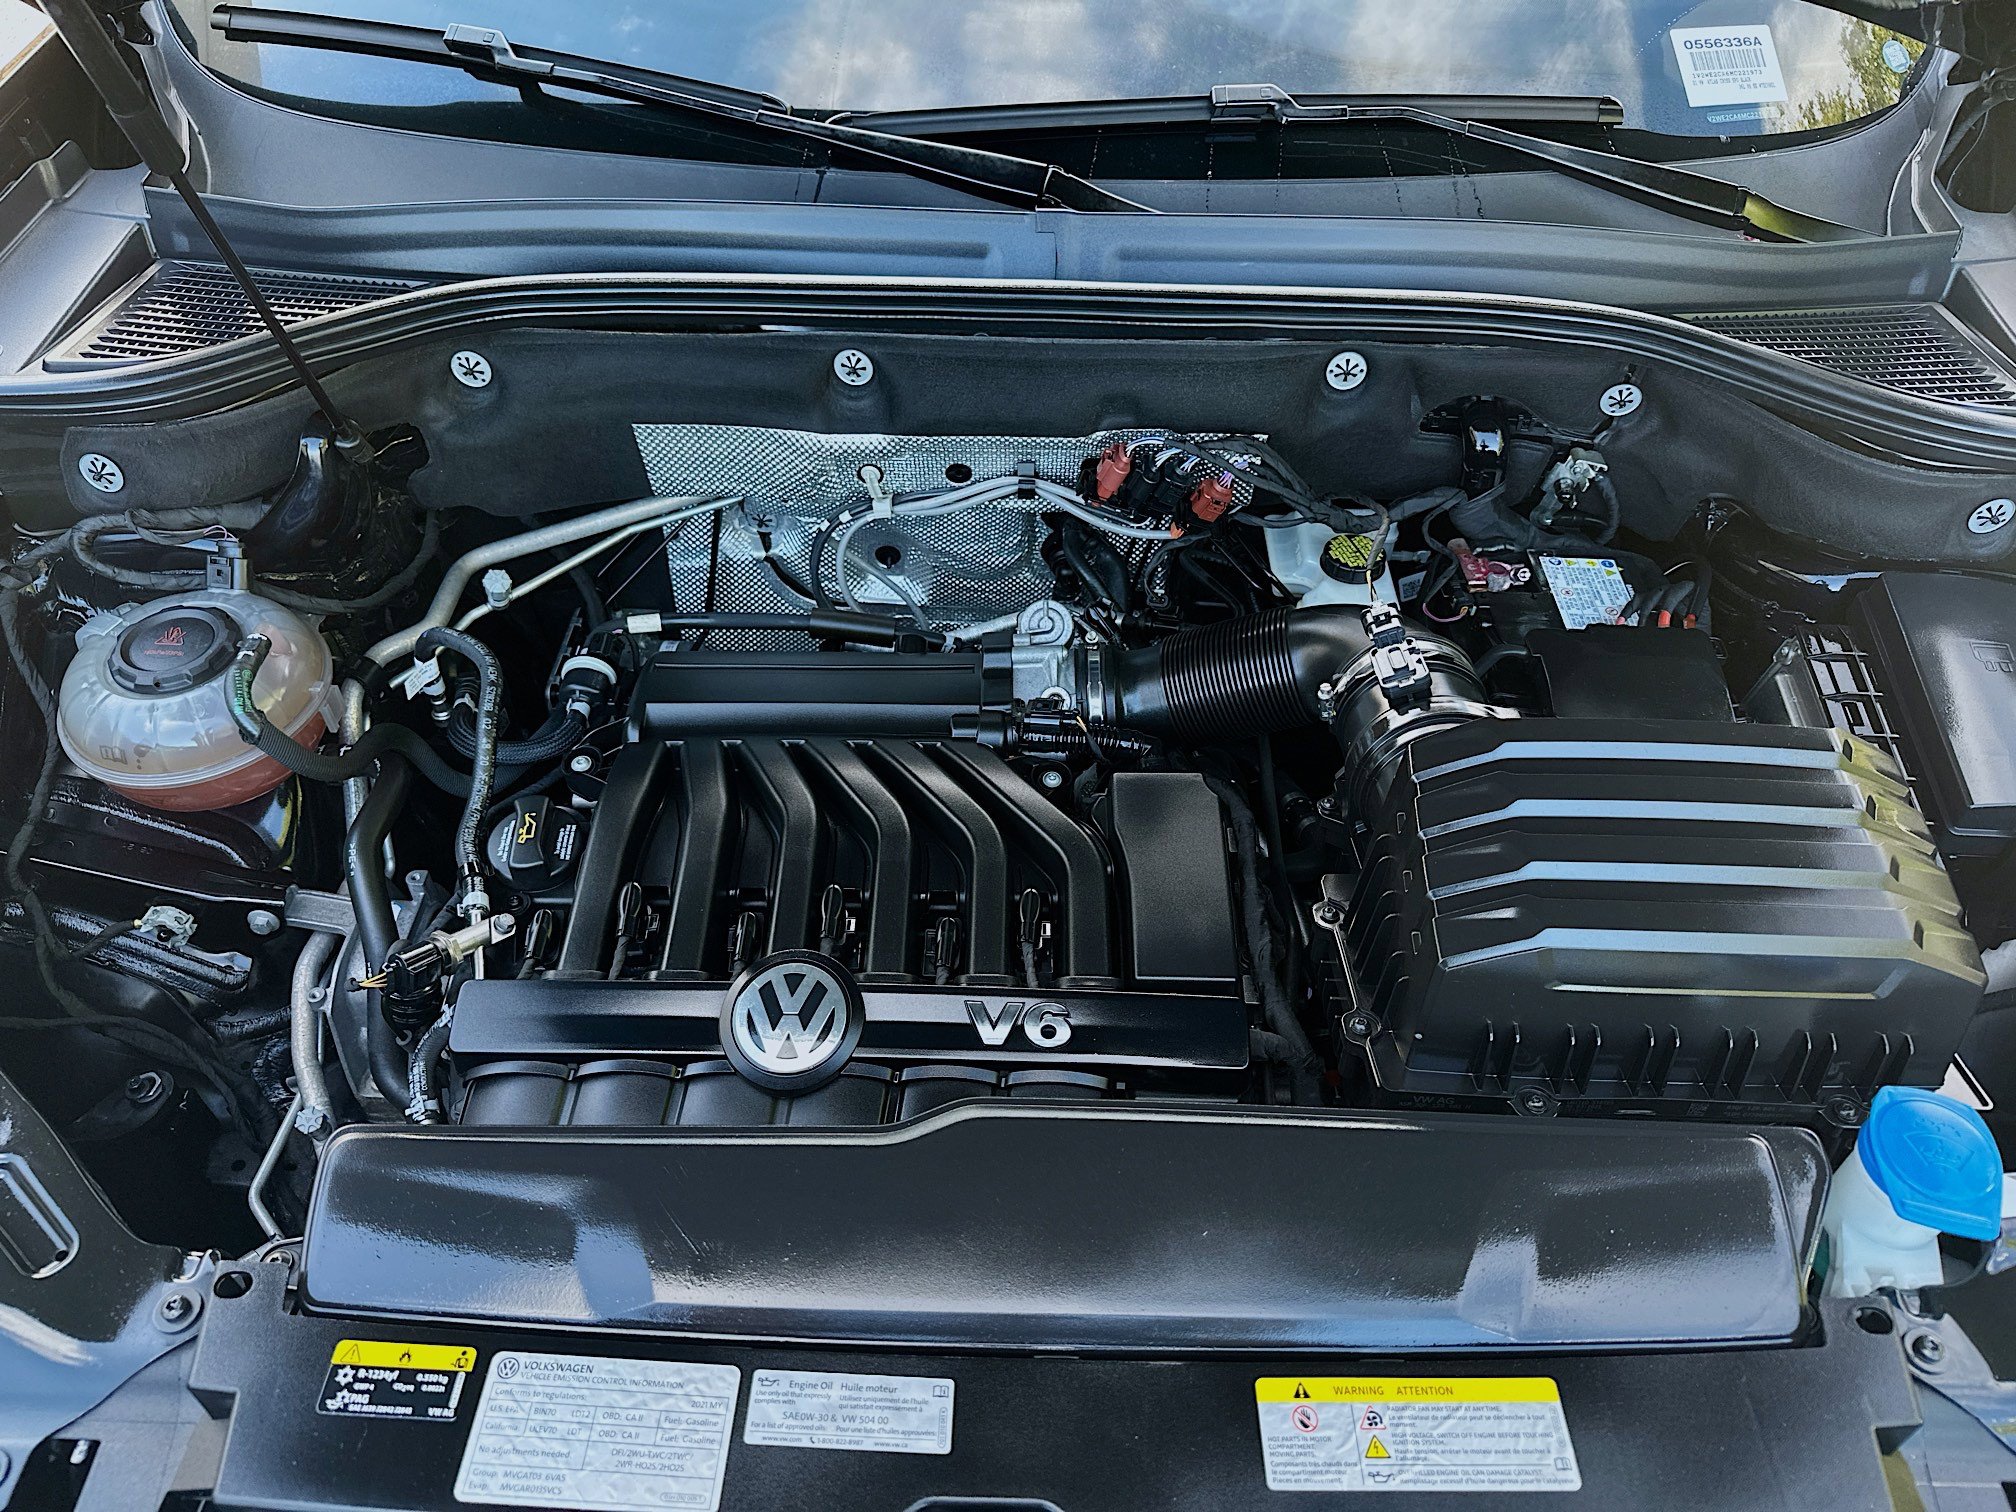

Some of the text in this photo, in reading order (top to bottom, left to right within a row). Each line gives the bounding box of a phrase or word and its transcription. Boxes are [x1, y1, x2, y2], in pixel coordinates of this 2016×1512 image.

[1684, 36, 1762, 50] 0556336A
[964, 1000, 1073, 1049] V6
[523, 1360, 595, 1375] VOLKSWAGEN
[520, 1371, 685, 1389] VEHICLE EMISSION CONTROL INFORMATION
[789, 1379, 834, 1391] Engine Oil
[494, 1387, 531, 1397] Conforms
[533, 1389, 541, 1398] to
[840, 1382, 898, 1394] Huile moteur
[1332, 1385, 1454, 1396] WARNING ATTENTION
[767, 1390, 781, 1398] only
[790, 1390, 803, 1398] that
[802, 1392, 832, 1400] expressly
[690, 1400, 723, 1409] 2021 MY
[754, 1397, 781, 1405] complies
[838, 1402, 849, 1410] qui
[850, 1402, 874, 1410] satisfait
[533, 1407, 557, 1416] BIN70
[625, 1412, 636, 1421] CA
[685, 1416, 720, 1427] Gasoline
[830, 1413, 837, 1422] &
[841, 1414, 857, 1424] VW
[859, 1415, 875, 1424] 504
[877, 1416, 889, 1425] 00
[750, 1420, 761, 1428] For
[766, 1421, 776, 1429] list
[785, 1423, 815, 1431] approved
[836, 1425, 850, 1433] Pour
[863, 1426, 876, 1434] liste
[621, 1430, 633, 1439] CA
[682, 1434, 717, 1445] Gasoline
[479, 1444, 491, 1453] No
[491, 1446, 539, 1458] adjustments
